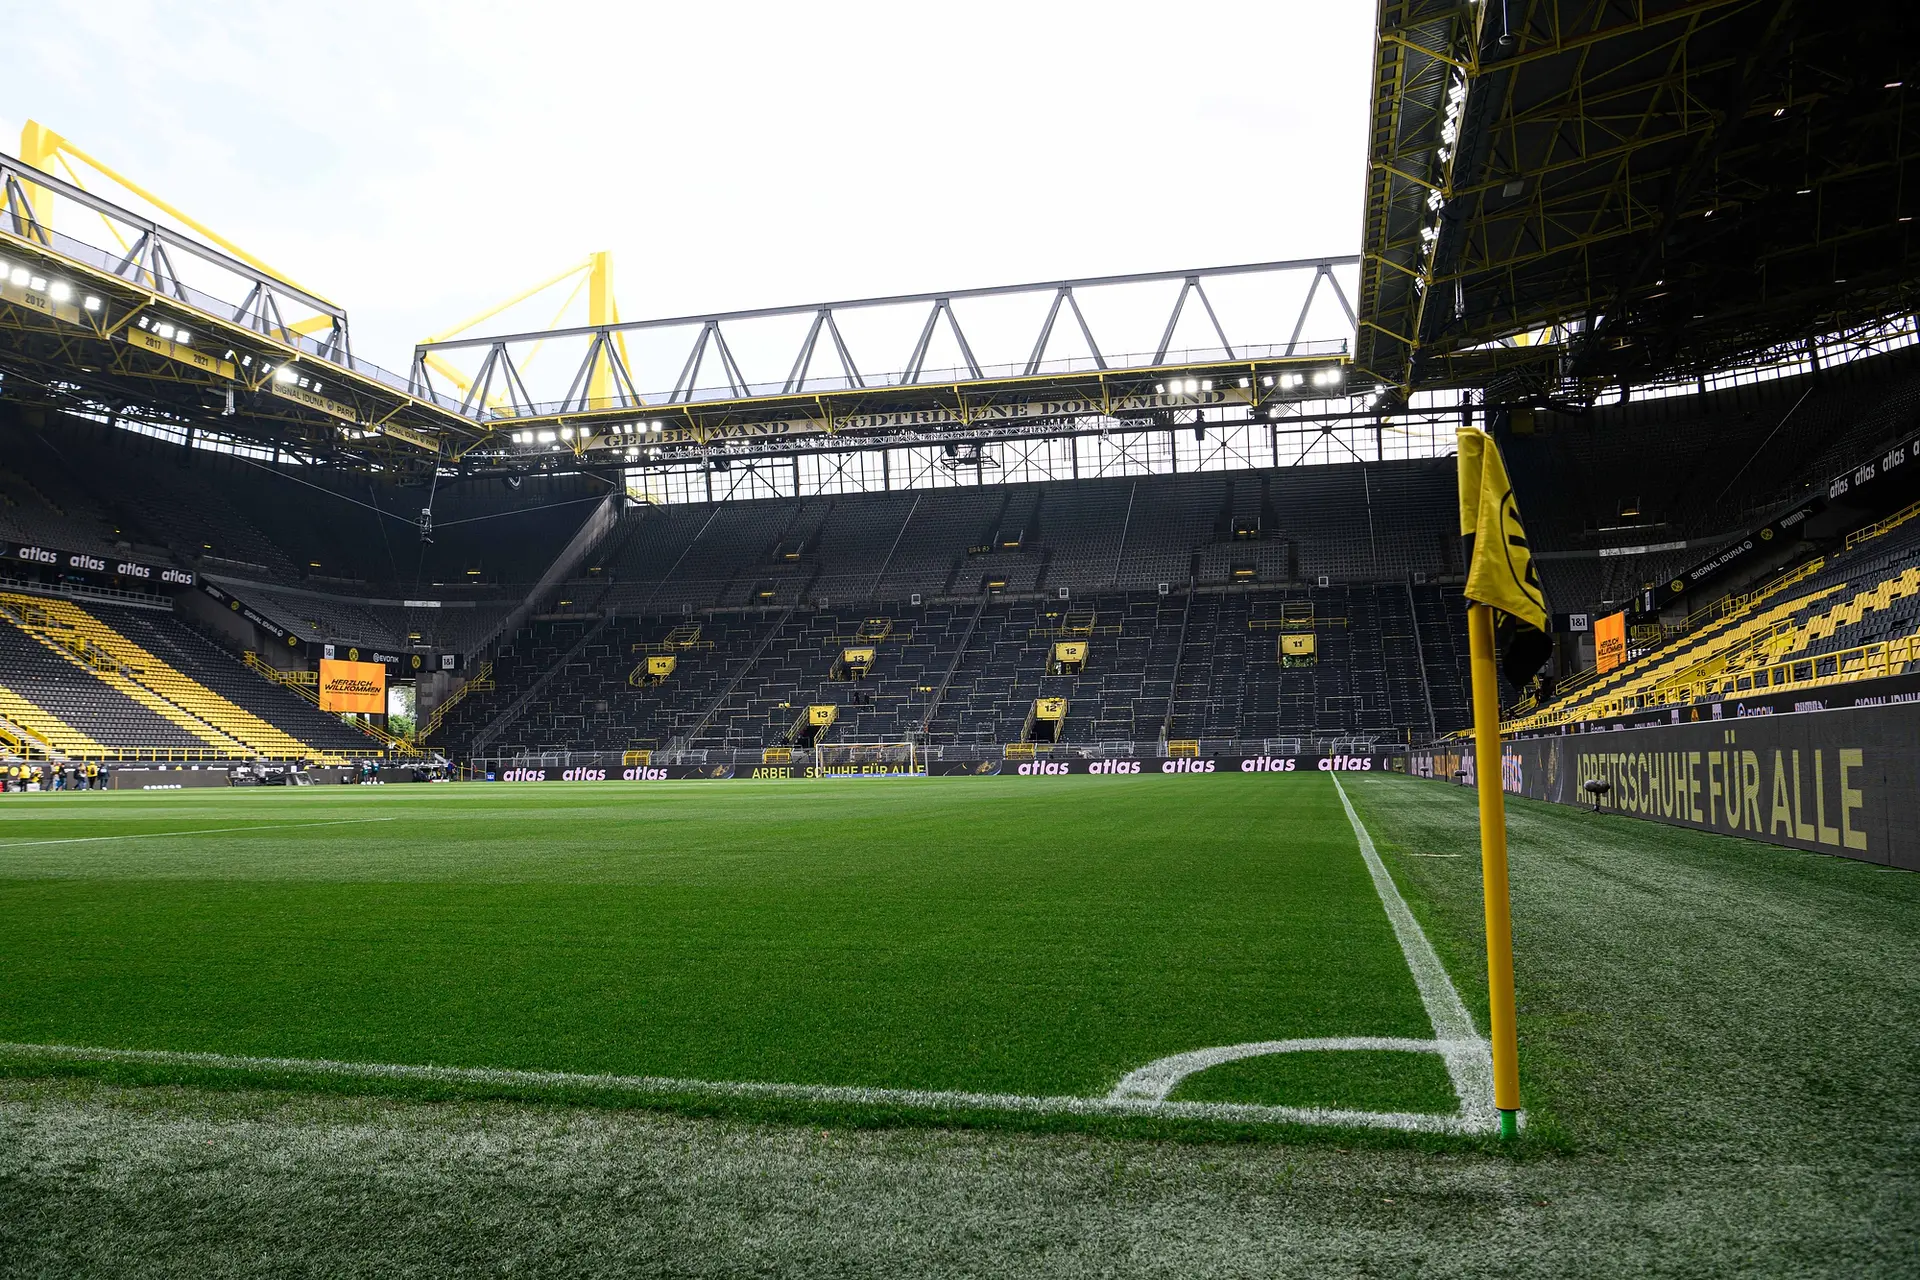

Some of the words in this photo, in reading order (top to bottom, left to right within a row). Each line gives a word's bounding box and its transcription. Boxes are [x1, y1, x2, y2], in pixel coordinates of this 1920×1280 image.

[25, 293, 46, 309] 2012
[145, 336, 162, 350] 2017
[193, 353, 209, 367] 2021
[274, 383, 301, 400] SIGNAL
[302, 393, 324, 408] IDUNA
[336, 406, 355, 420] PARK
[604, 429, 692, 447] GELBE
[708, 421, 790, 438] WAND
[834, 404, 1028, 429] SÜDTRIBÜNE
[1041, 391, 1226, 415] DORTMUND
[425, 437, 438, 448] PARK
[1830, 478, 1848, 498] atlas
[1855, 464, 1875, 485] atlas
[1882, 448, 1904, 471] atlas
[1780, 511, 1804, 528] PUMA
[19, 547, 57, 564] atlas
[70, 555, 105, 571] atlas
[117, 562, 150, 578] atlas
[161, 569, 192, 585] atlas
[1691, 561, 1720, 580] SIGNAL
[1720, 545, 1745, 564] IDUNA
[1571, 617, 1586, 627] 1&1
[1065, 647, 1077, 655] 12
[1293, 640, 1303, 648] 11
[379, 655, 400, 663] EVONIK
[655, 661, 667, 669] 14
[1696, 669, 1706, 677] 26
[325, 684, 381, 693] WILLKOMMEN
[816, 710, 829, 719] 13
[1045, 705, 1057, 713] 12
[862, 763, 888, 775] FÜR
[1017, 760, 1069, 775] atlas
[1088, 759, 1141, 774] atlas
[1162, 758, 1216, 773] atlas
[1241, 756, 1296, 772] atlas
[1318, 755, 1371, 771] atlas
[503, 767, 546, 782] atlas
[562, 767, 606, 781] atlas
[623, 766, 668, 781] atlas
[1576, 750, 1704, 823] ARBEITSSCHUHE
[1708, 729, 1764, 833] FÜR
[1770, 748, 1868, 851] ALLE
